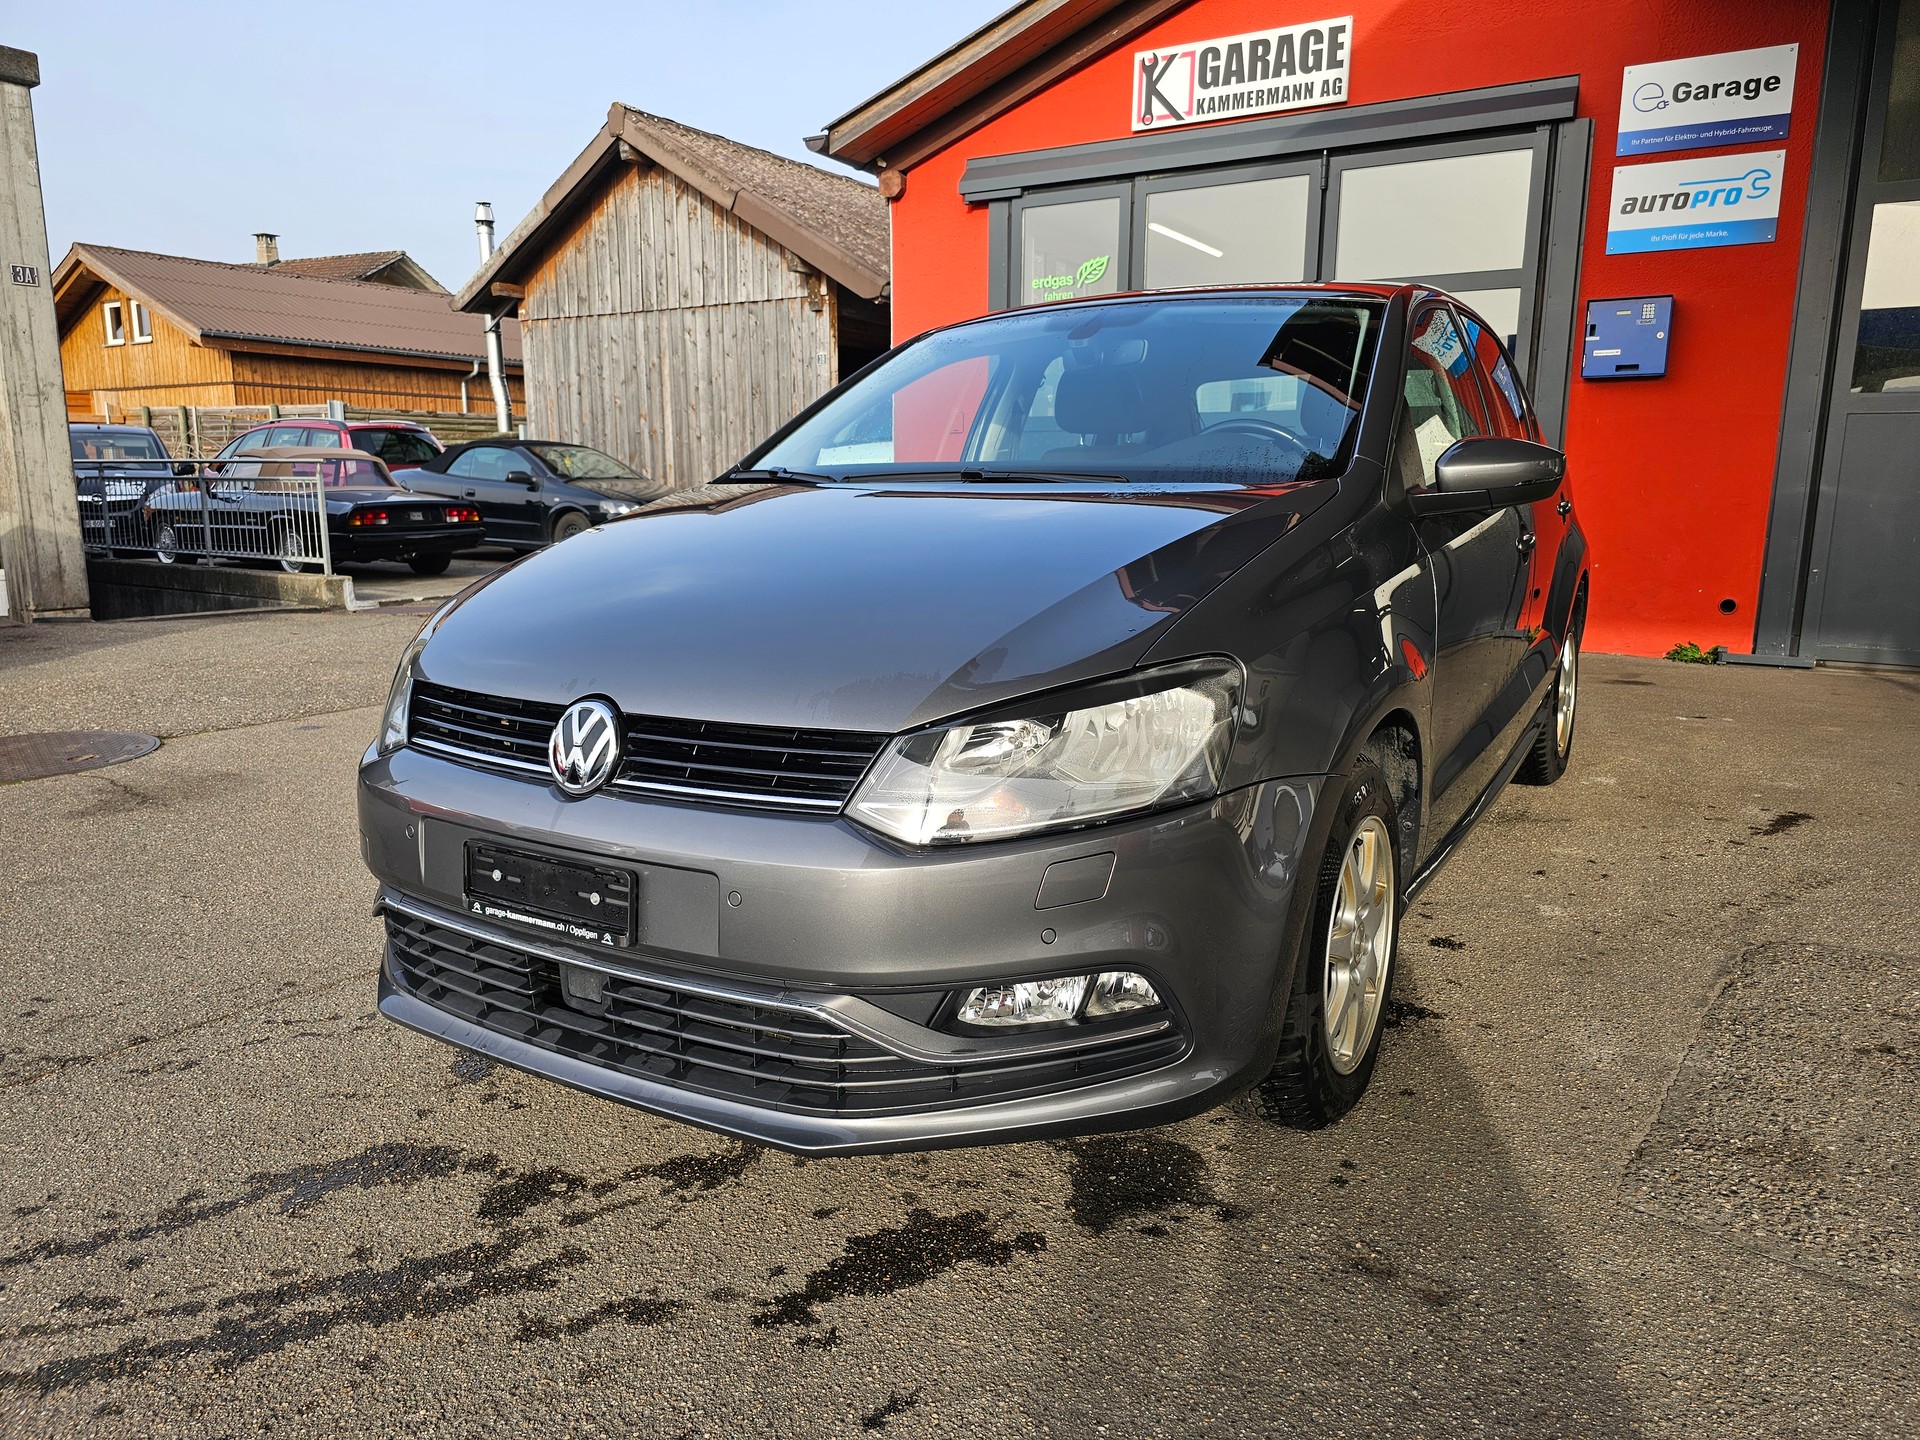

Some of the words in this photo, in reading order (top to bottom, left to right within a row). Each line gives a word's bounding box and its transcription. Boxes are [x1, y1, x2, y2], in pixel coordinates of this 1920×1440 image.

[1197, 24, 1347, 90] GARAGE
[1196, 81, 1315, 116] KAMMERMANN
[1320, 77, 1343, 97] AG
[1671, 75, 1781, 104] Garage
[1631, 138, 1640, 146] Ihr
[1640, 136, 1664, 145] Partner
[1664, 134, 1674, 142] für
[1674, 133, 1699, 141] Elektro-
[1699, 130, 1714, 138] und
[1714, 125, 1774, 138] Hybrid-Fahrzeuge.
[1661, 233, 1677, 242] Profi
[1678, 232, 1688, 240] für
[1688, 231, 1705, 241] jede
[1705, 229, 1729, 238] Marke.
[16, 266, 34, 284] 3A
[1031, 274, 1074, 290] erdgas
[1044, 291, 1074, 302] fahren
[484, 905, 566, 932] garage-kammermann.ch
[569, 924, 598, 940] Oppligen
